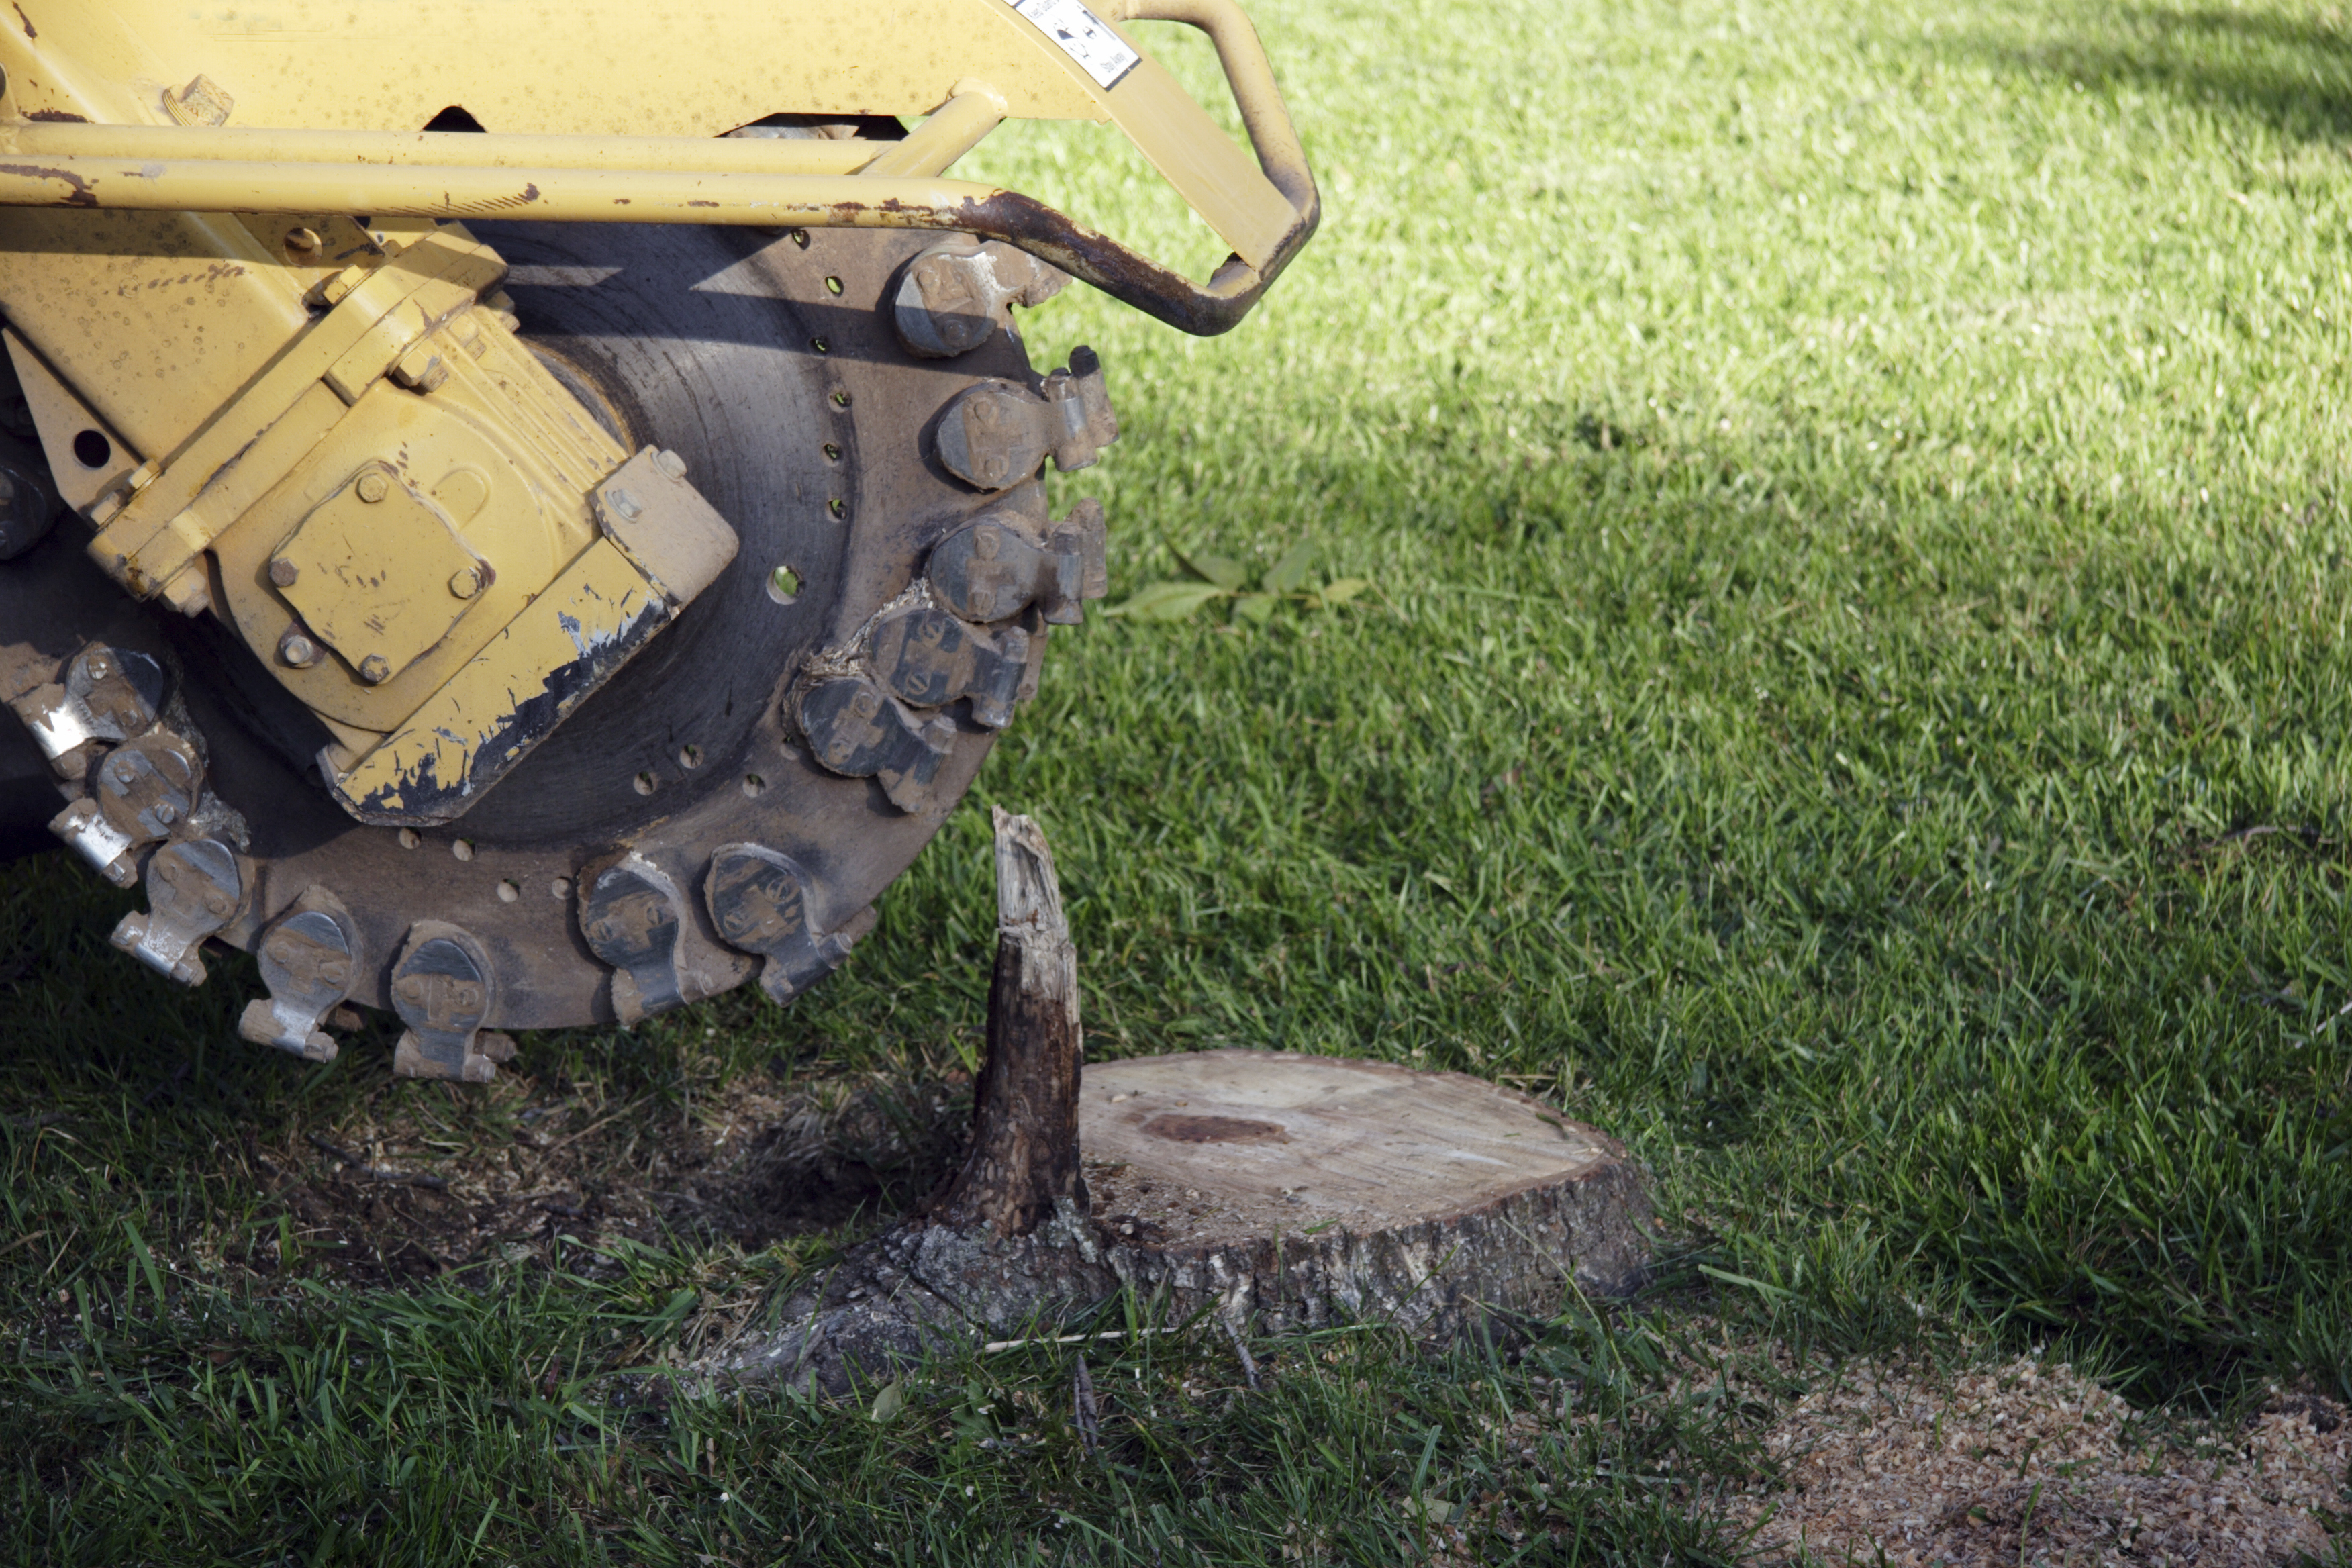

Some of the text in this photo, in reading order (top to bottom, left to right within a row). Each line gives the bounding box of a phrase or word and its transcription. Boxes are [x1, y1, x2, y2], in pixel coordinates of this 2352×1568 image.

[1027, 8, 1044, 19] Keep
[1099, 51, 1129, 73] Stay Away
